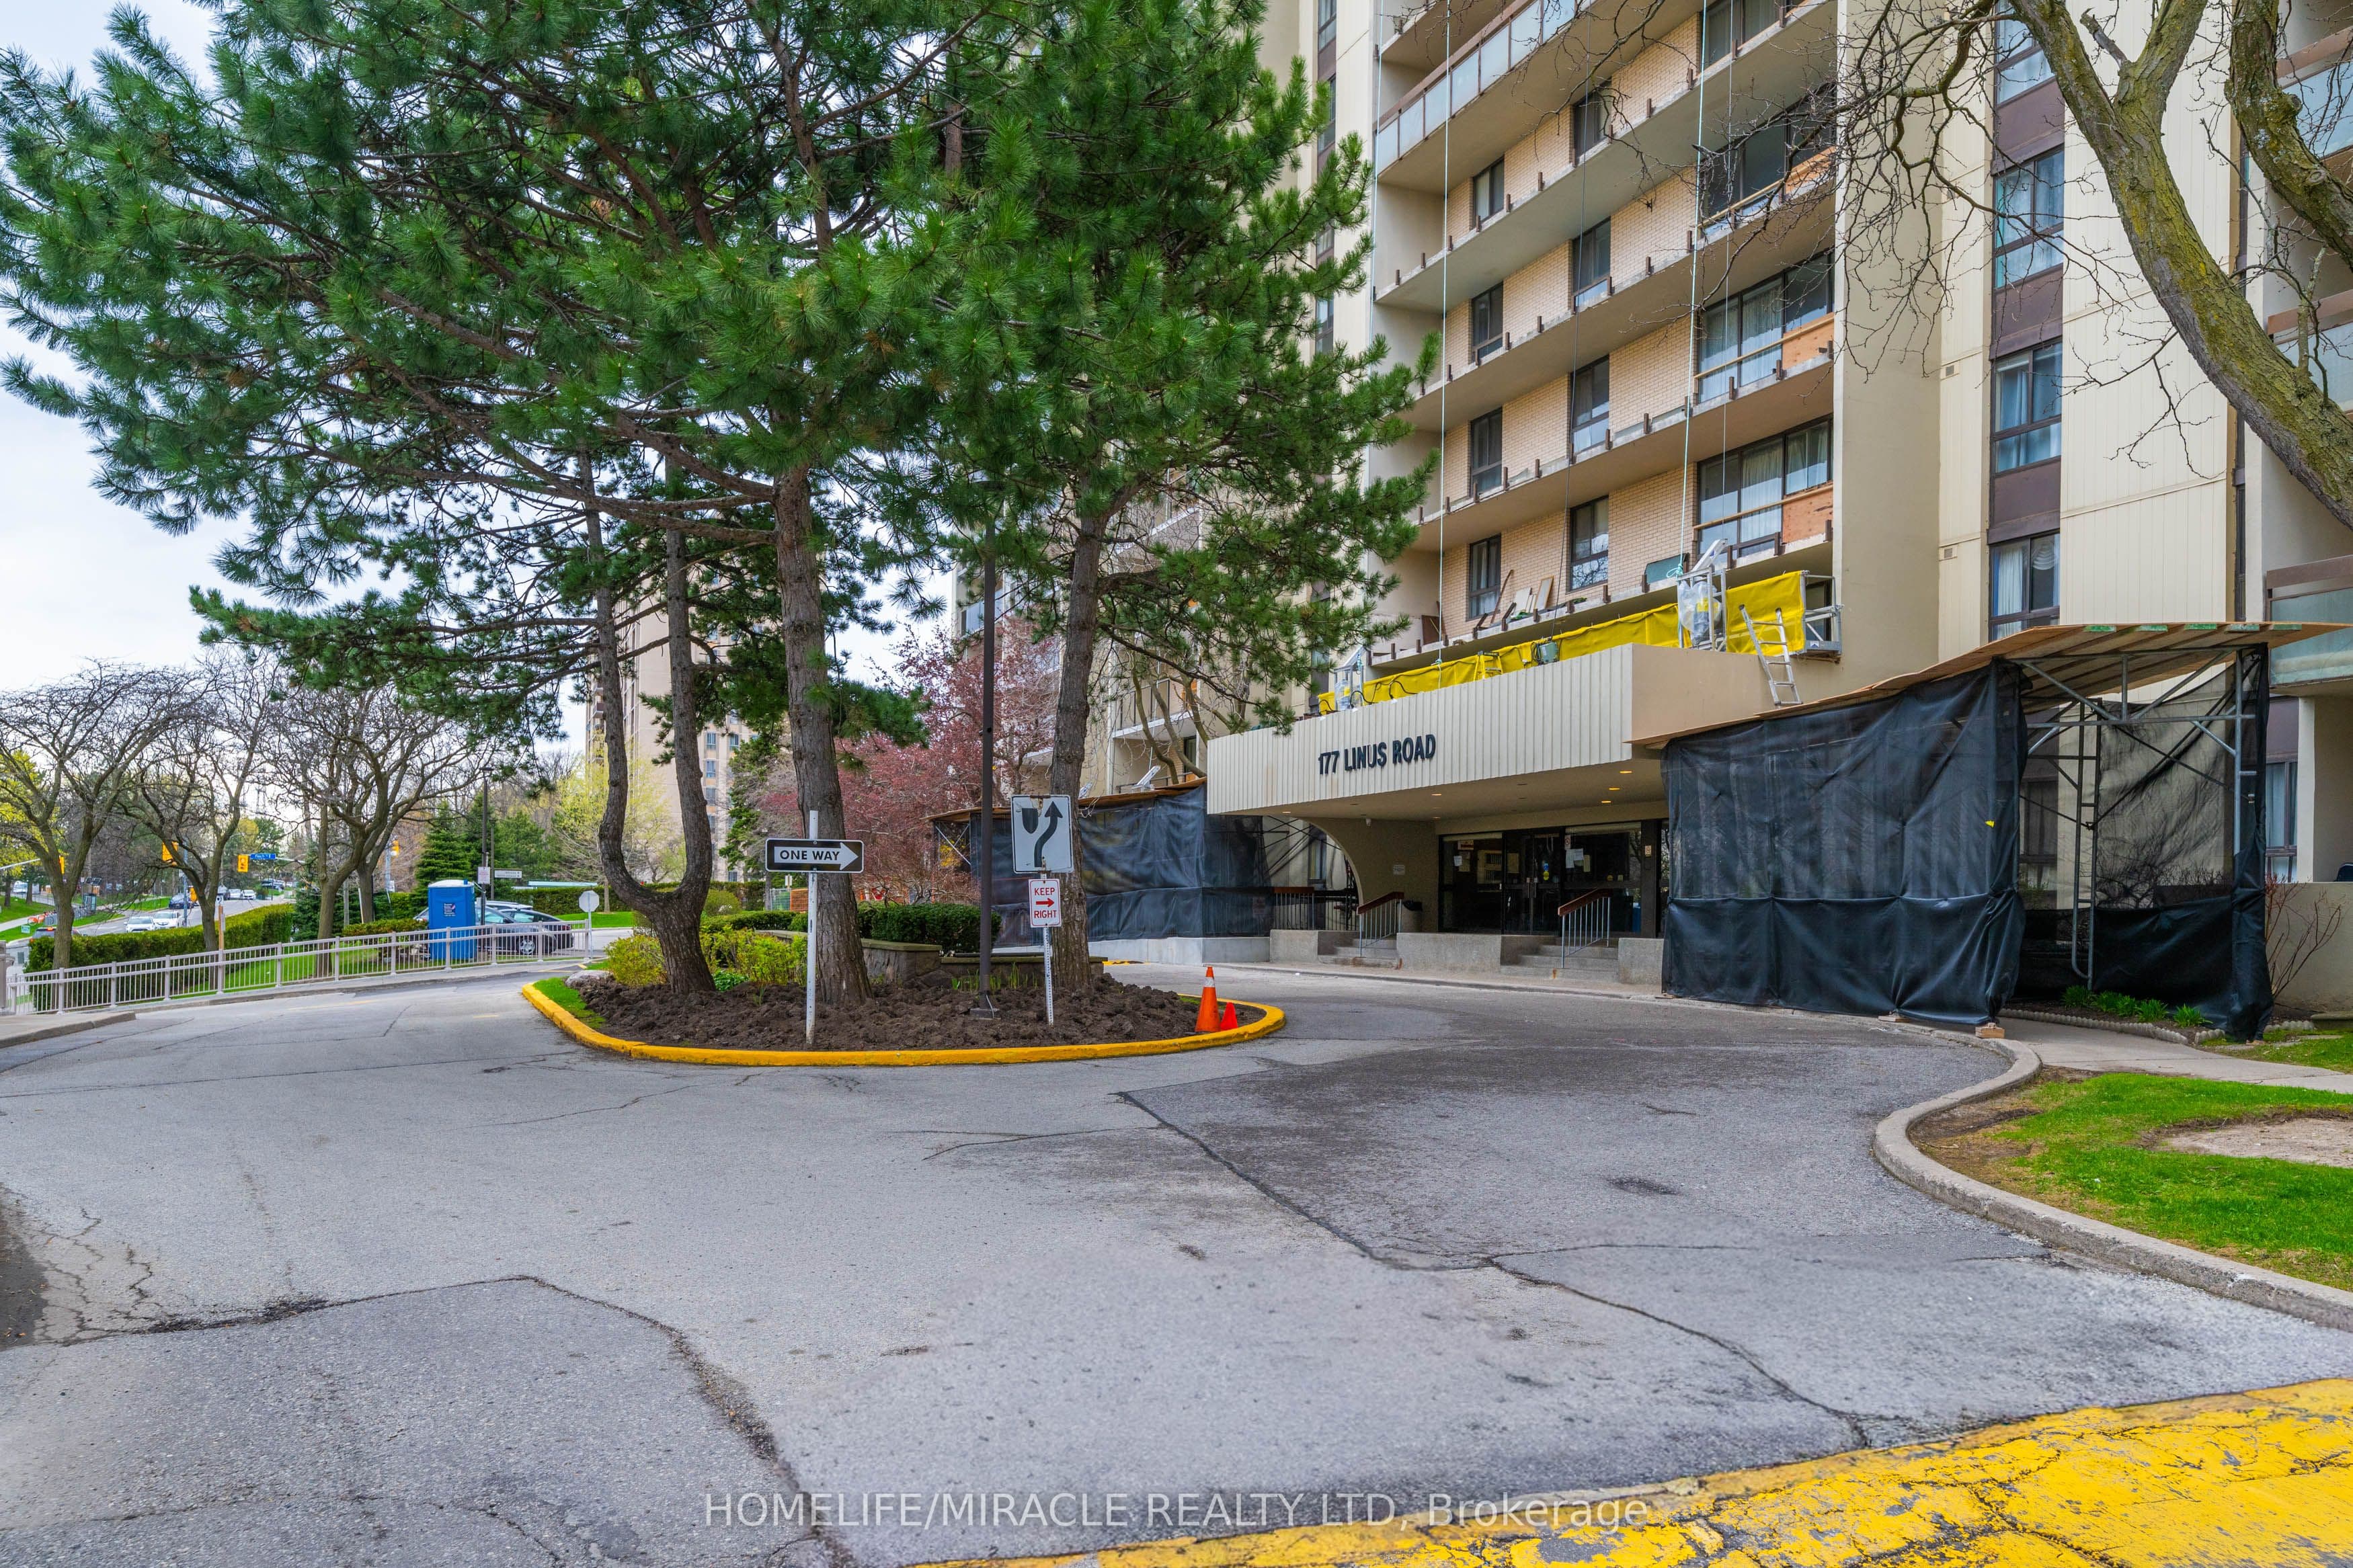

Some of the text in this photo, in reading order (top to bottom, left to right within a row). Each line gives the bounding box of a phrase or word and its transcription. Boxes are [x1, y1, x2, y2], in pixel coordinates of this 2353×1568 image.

[1318, 734, 1436, 775] 177 LINUS ROAD
[780, 850, 840, 861] ONE WAY
[1034, 887, 1055, 896] KEEP
[1034, 909, 1057, 919] RIGHT
